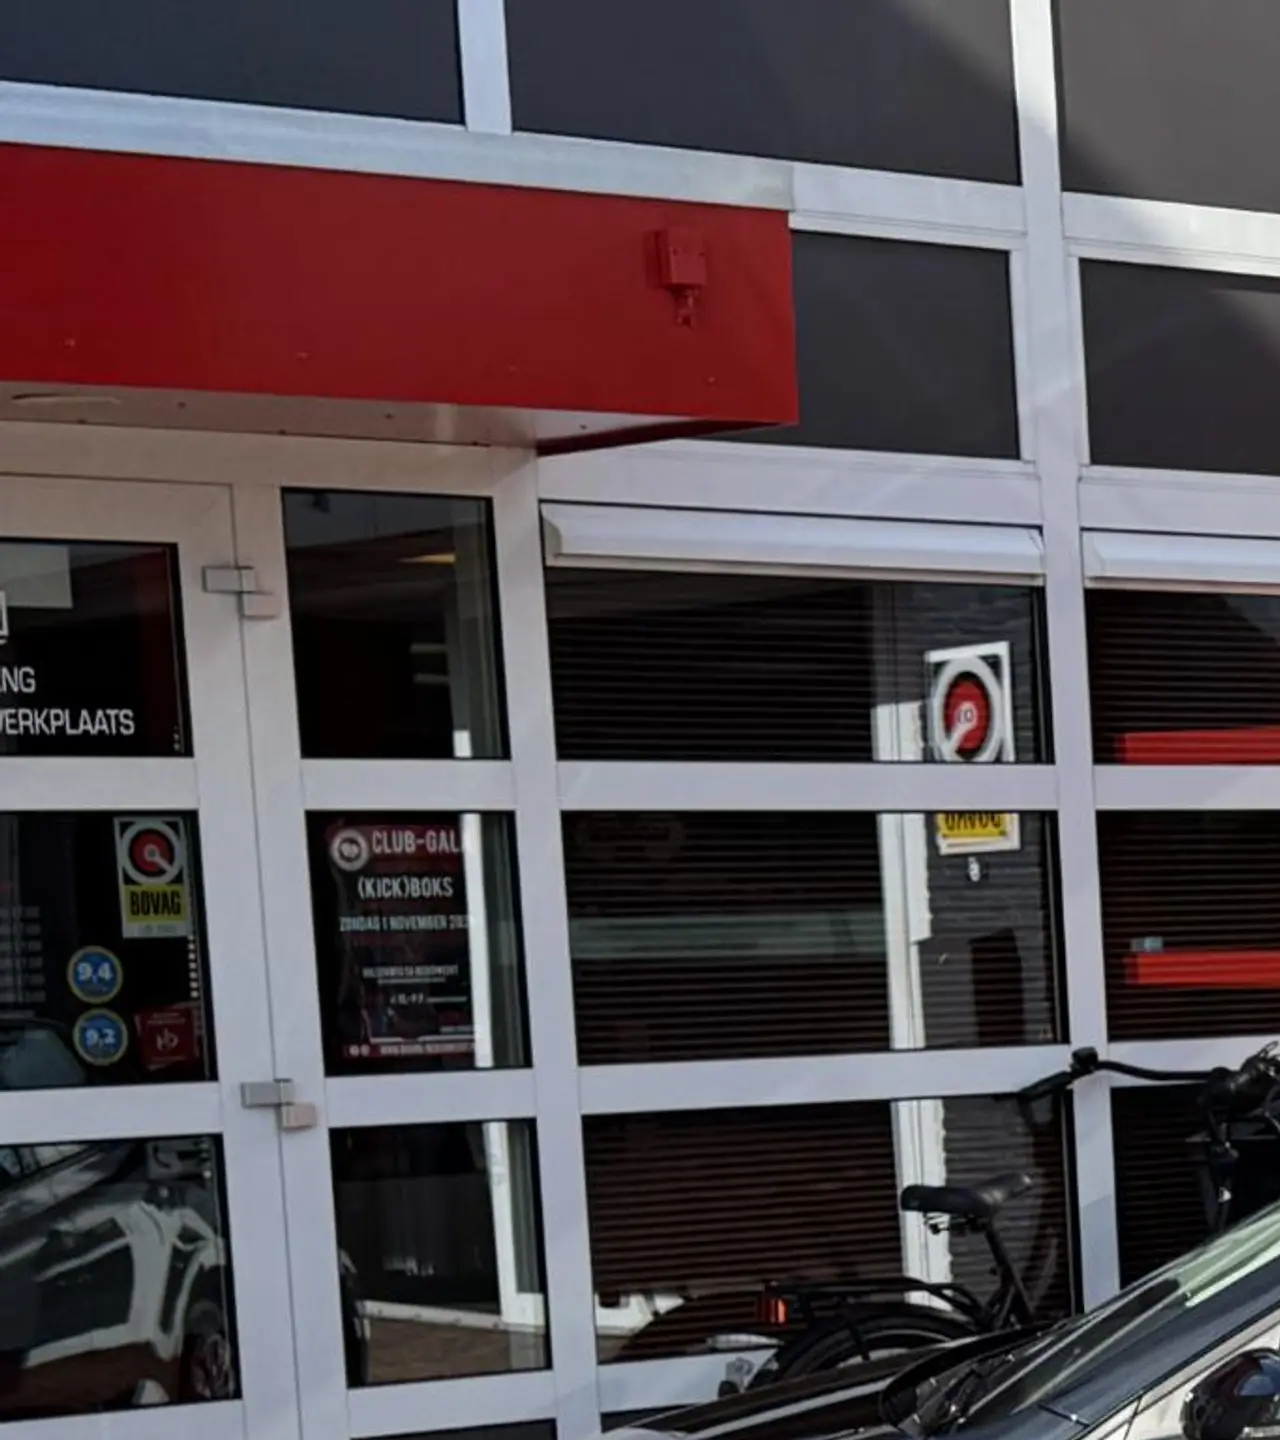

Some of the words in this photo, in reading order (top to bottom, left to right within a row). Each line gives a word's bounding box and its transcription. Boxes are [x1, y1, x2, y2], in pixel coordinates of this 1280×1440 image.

[0, 666, 36, 693] NG
[0, 708, 135, 735] ERKPLAATS
[357, 876, 453, 900] (KICK)BOKS
[129, 890, 182, 916] BOVAG
